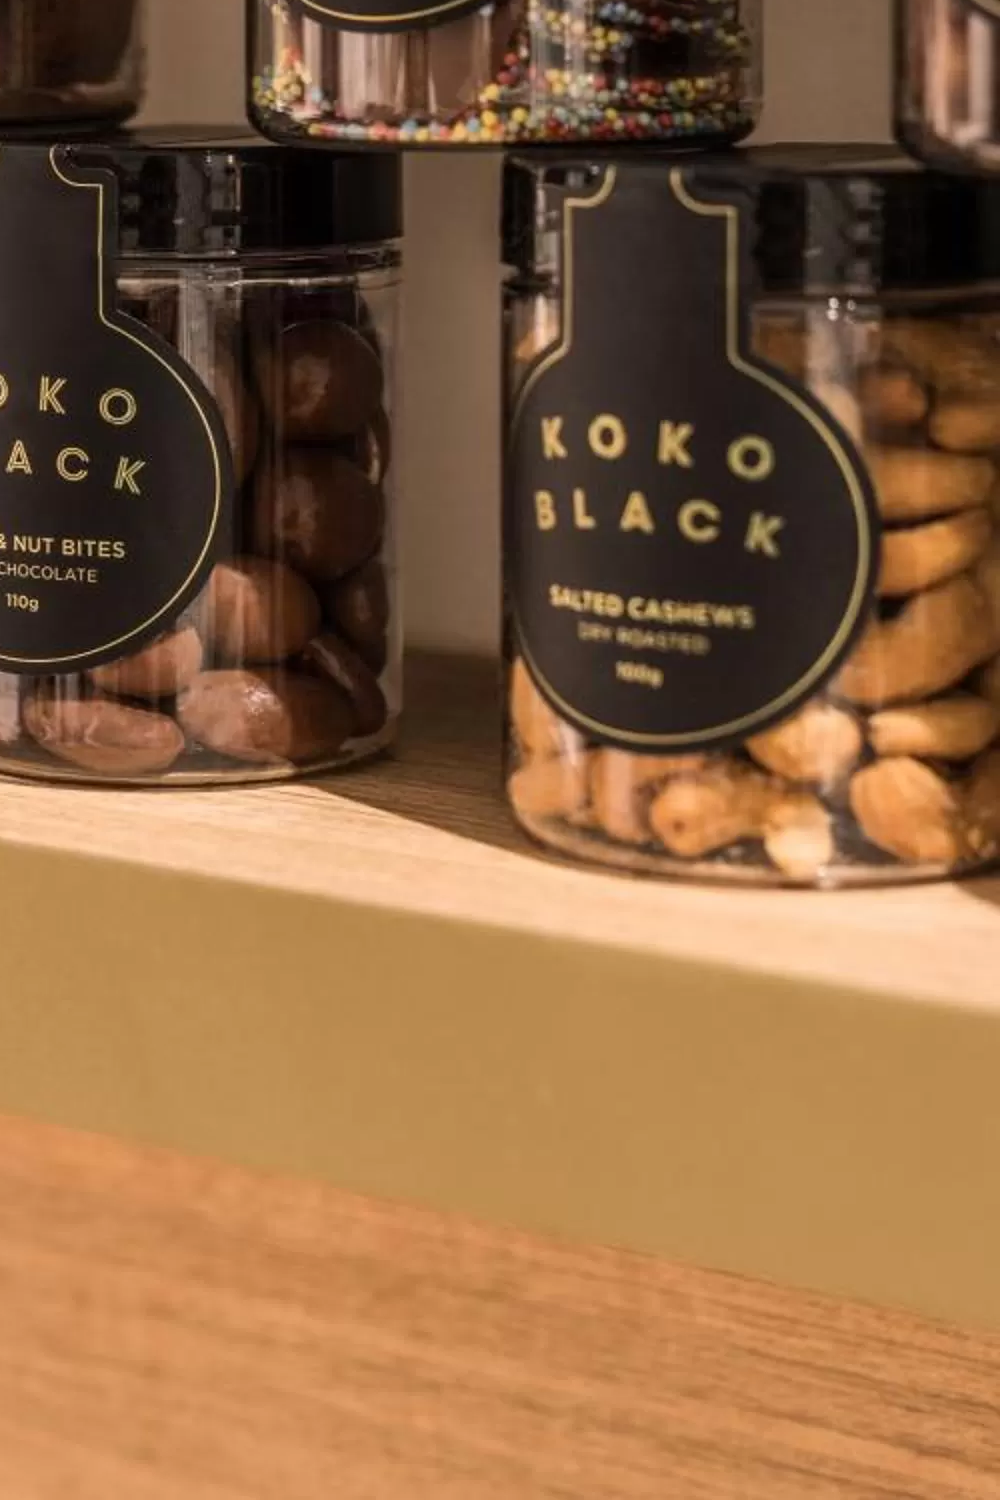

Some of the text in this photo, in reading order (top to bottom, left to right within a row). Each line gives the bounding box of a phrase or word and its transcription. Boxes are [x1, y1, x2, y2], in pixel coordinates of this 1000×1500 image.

[541, 413, 775, 482] KOKO
[534, 488, 784, 558] BLACK
[13, 534, 55, 555] NUT
[61, 538, 126, 559] BITES
[5, 592, 40, 612] 110g
[549, 583, 755, 629] SALTED CASHEWS
